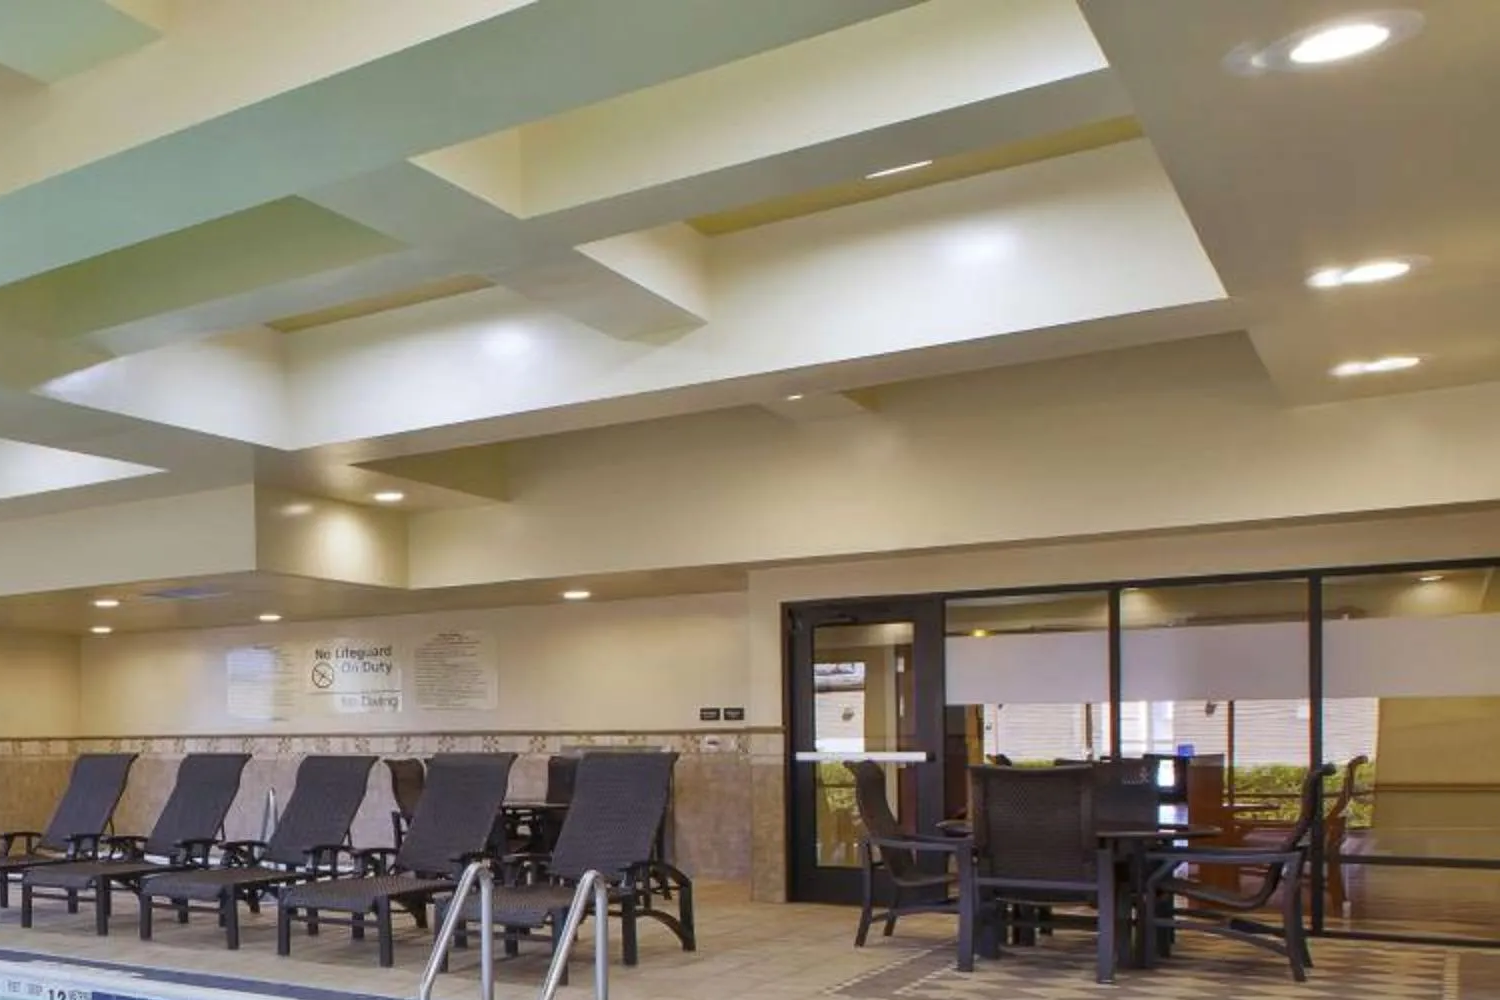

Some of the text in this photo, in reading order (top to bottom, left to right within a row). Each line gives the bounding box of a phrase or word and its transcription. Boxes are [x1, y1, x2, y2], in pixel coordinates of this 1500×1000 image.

[315, 645, 393, 660] No Lifeguard
[362, 660, 393, 676] Duty
